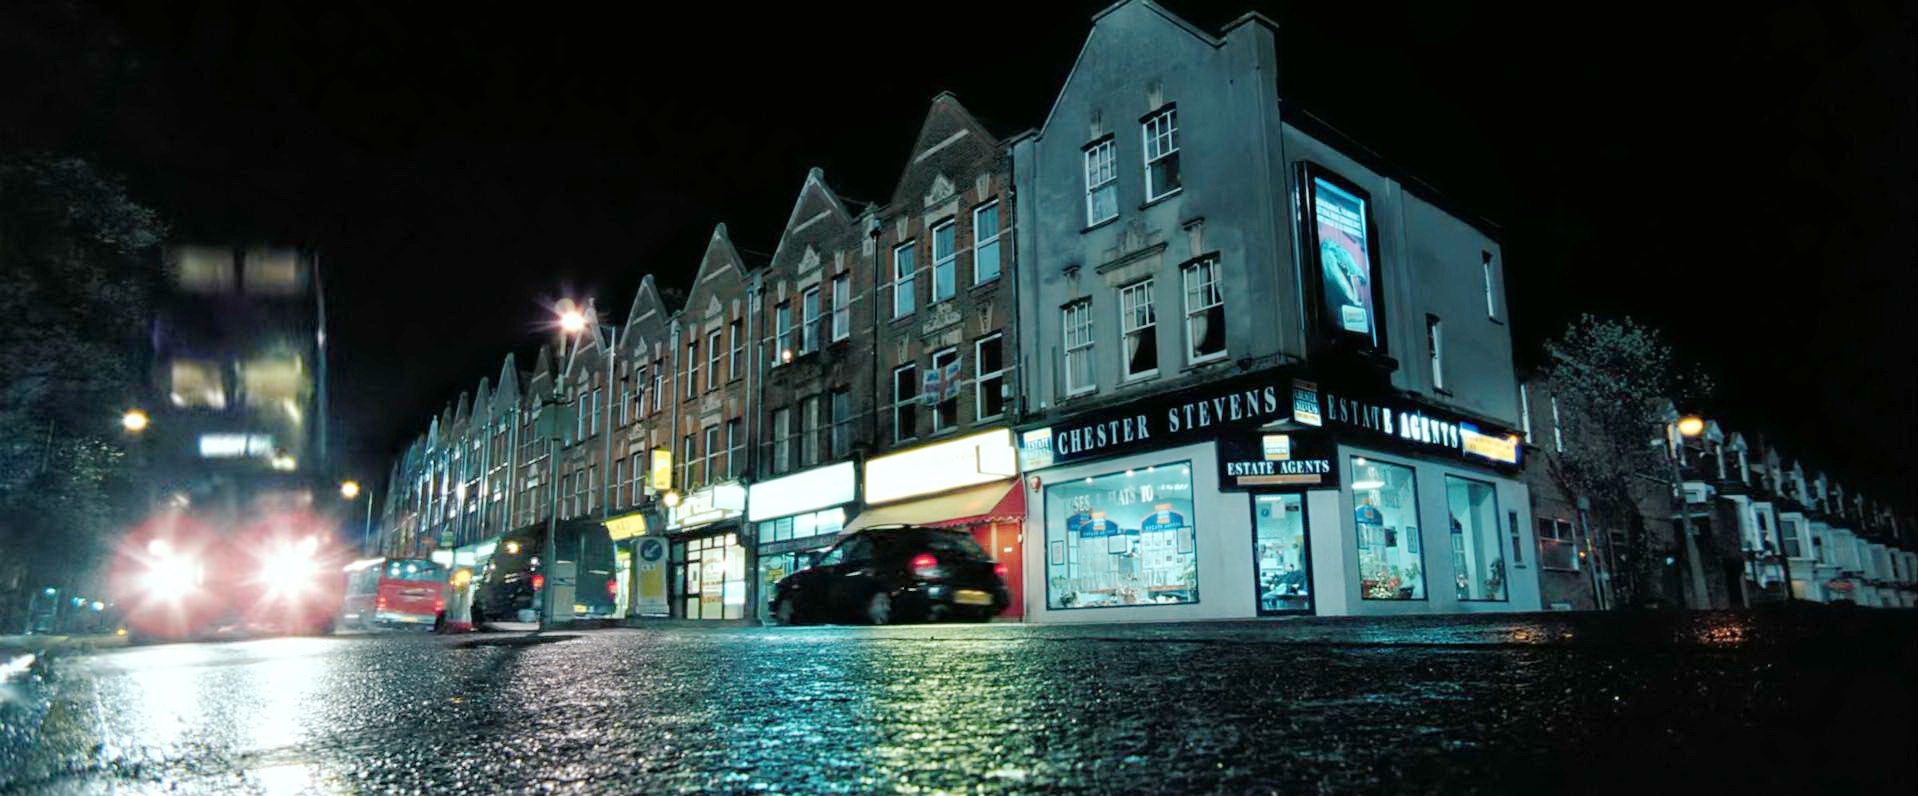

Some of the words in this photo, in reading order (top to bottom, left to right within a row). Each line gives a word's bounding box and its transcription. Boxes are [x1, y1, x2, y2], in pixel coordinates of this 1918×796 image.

[1057, 415, 1150, 455] CHESTER
[1168, 386, 1277, 433] STEVENS
[1327, 393, 1393, 434] ESTATE
[1400, 412, 1458, 448] AGENTS
[1227, 461, 1275, 476] ESTATE
[1280, 459, 1330, 474] AGENTS
[1140, 484, 1154, 503] TO
